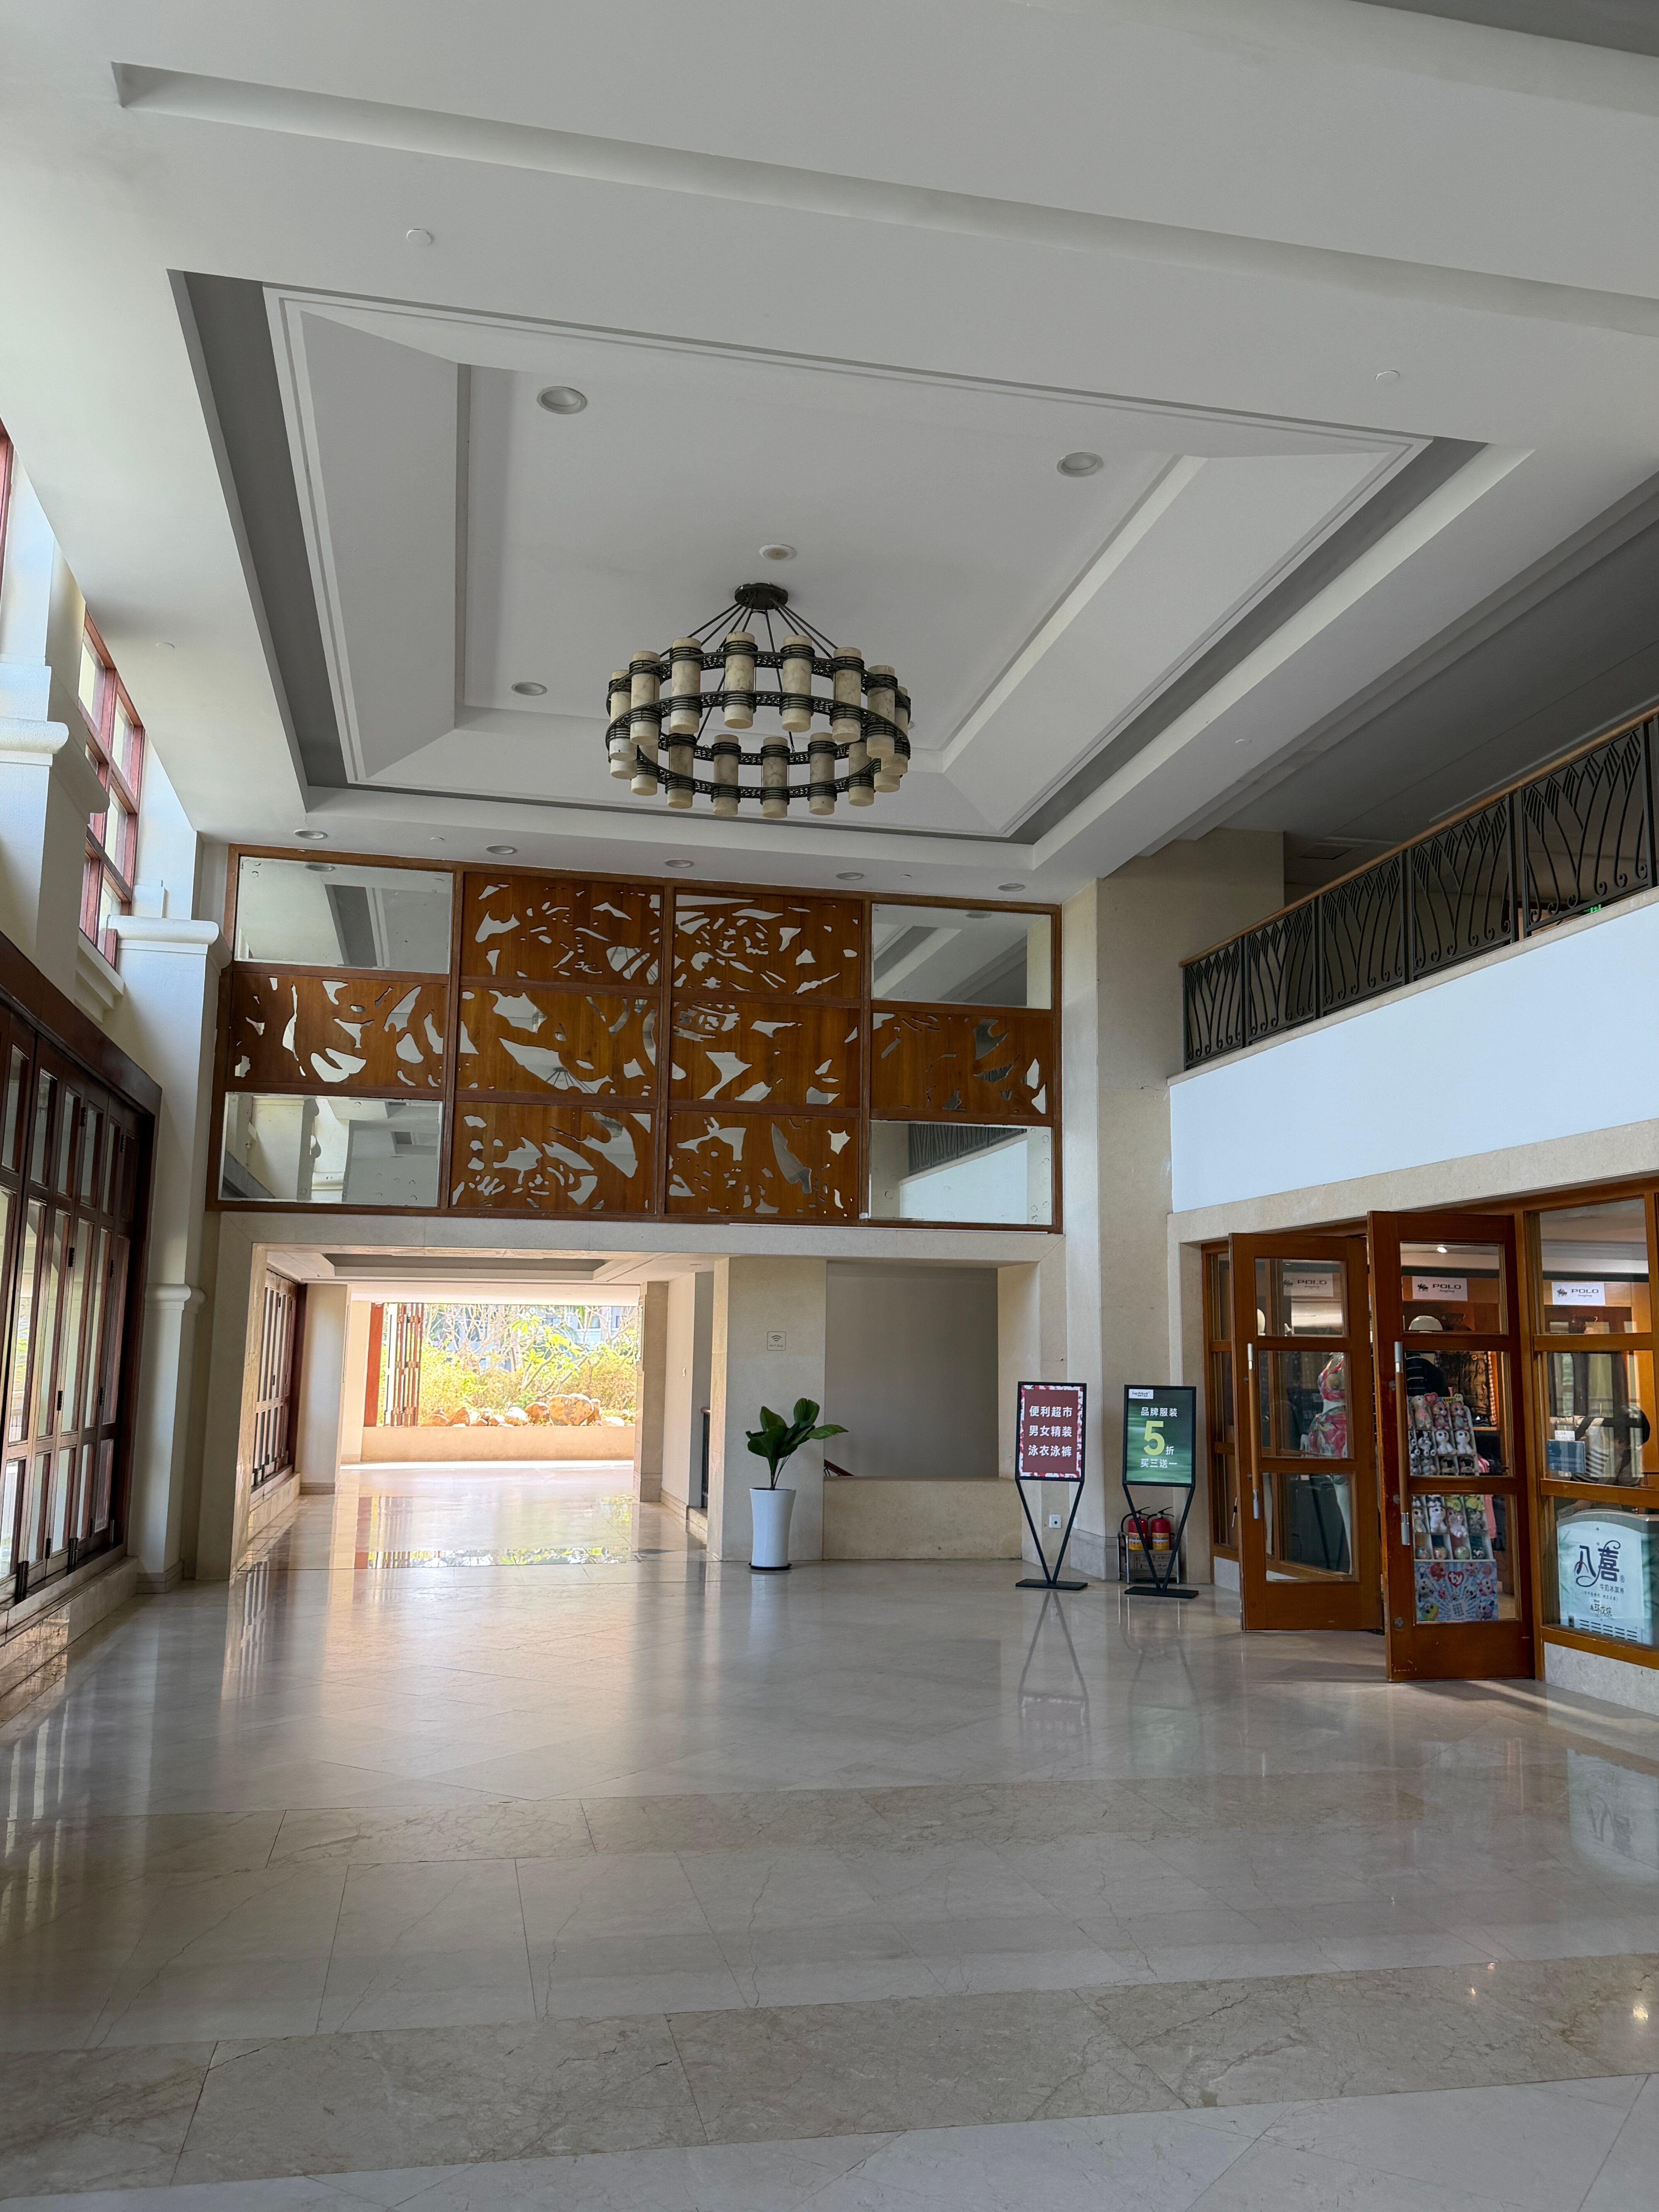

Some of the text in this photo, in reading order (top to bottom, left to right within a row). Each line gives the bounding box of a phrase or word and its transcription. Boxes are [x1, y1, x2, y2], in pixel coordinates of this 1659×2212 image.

[1029, 1405, 1073, 1418] 便利超市
[1140, 1407, 1178, 1417] 品牌服装
[1029, 1425, 1072, 1437] 男女精装
[1028, 1444, 1072, 1457] 泳衣泳裤
[1140, 1458, 1178, 1468] 买三送一
[1574, 1540, 1621, 1587] 八喜
